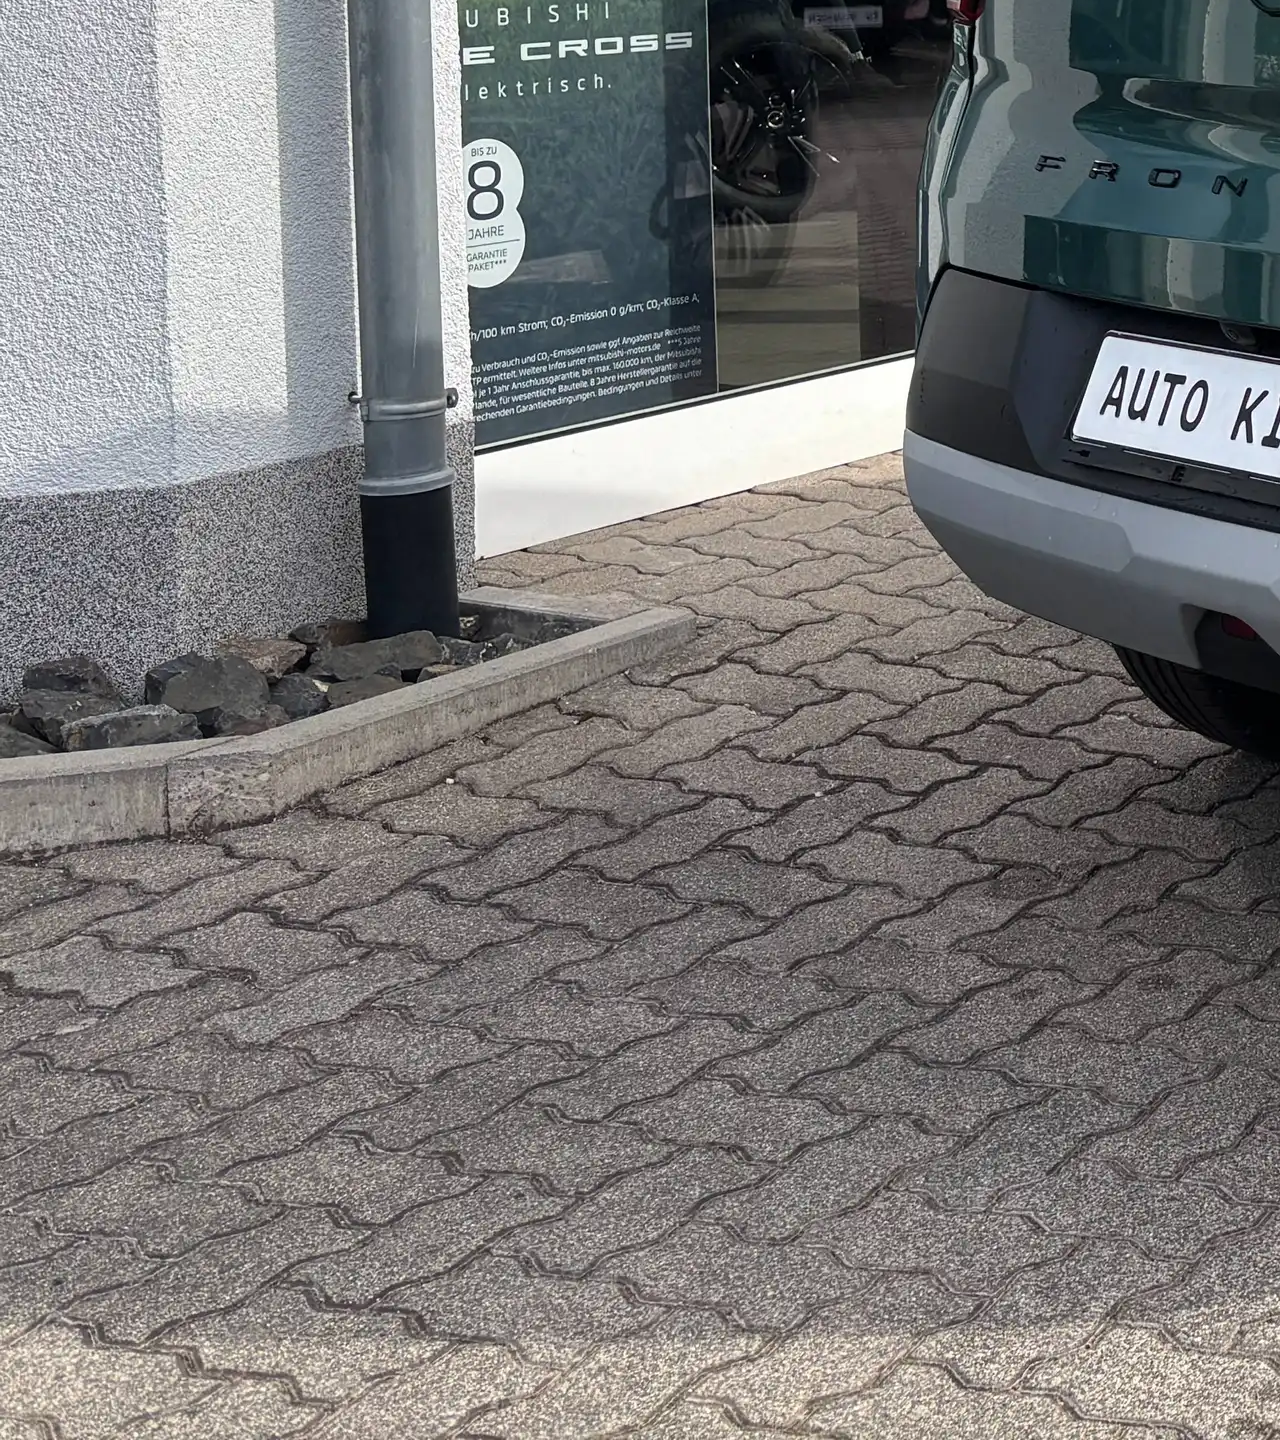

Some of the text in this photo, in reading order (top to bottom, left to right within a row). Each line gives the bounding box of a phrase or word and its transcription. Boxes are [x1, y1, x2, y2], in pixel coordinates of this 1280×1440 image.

[520, 31, 693, 61] CROSS
[471, 146, 498, 157] BIS ZU
[467, 160, 504, 220] 8
[468, 225, 505, 241] JAHRE
[466, 248, 508, 263] GARANTIE
[500, 325, 516, 337] km
[610, 306, 617, 317] 0
[481, 357, 520, 372] Verbrauch
[521, 353, 536, 364] und
[518, 364, 547, 376] Weitere
[548, 359, 567, 372] Infos
[567, 357, 587, 367] unter
[493, 383, 511, 395] Jahr
[499, 395, 511, 405] für
[510, 385, 556, 402] wesentliche
[589, 377, 595, 386] 8
[595, 373, 617, 386] Jahre
[1099, 365, 1210, 433] AUTO
